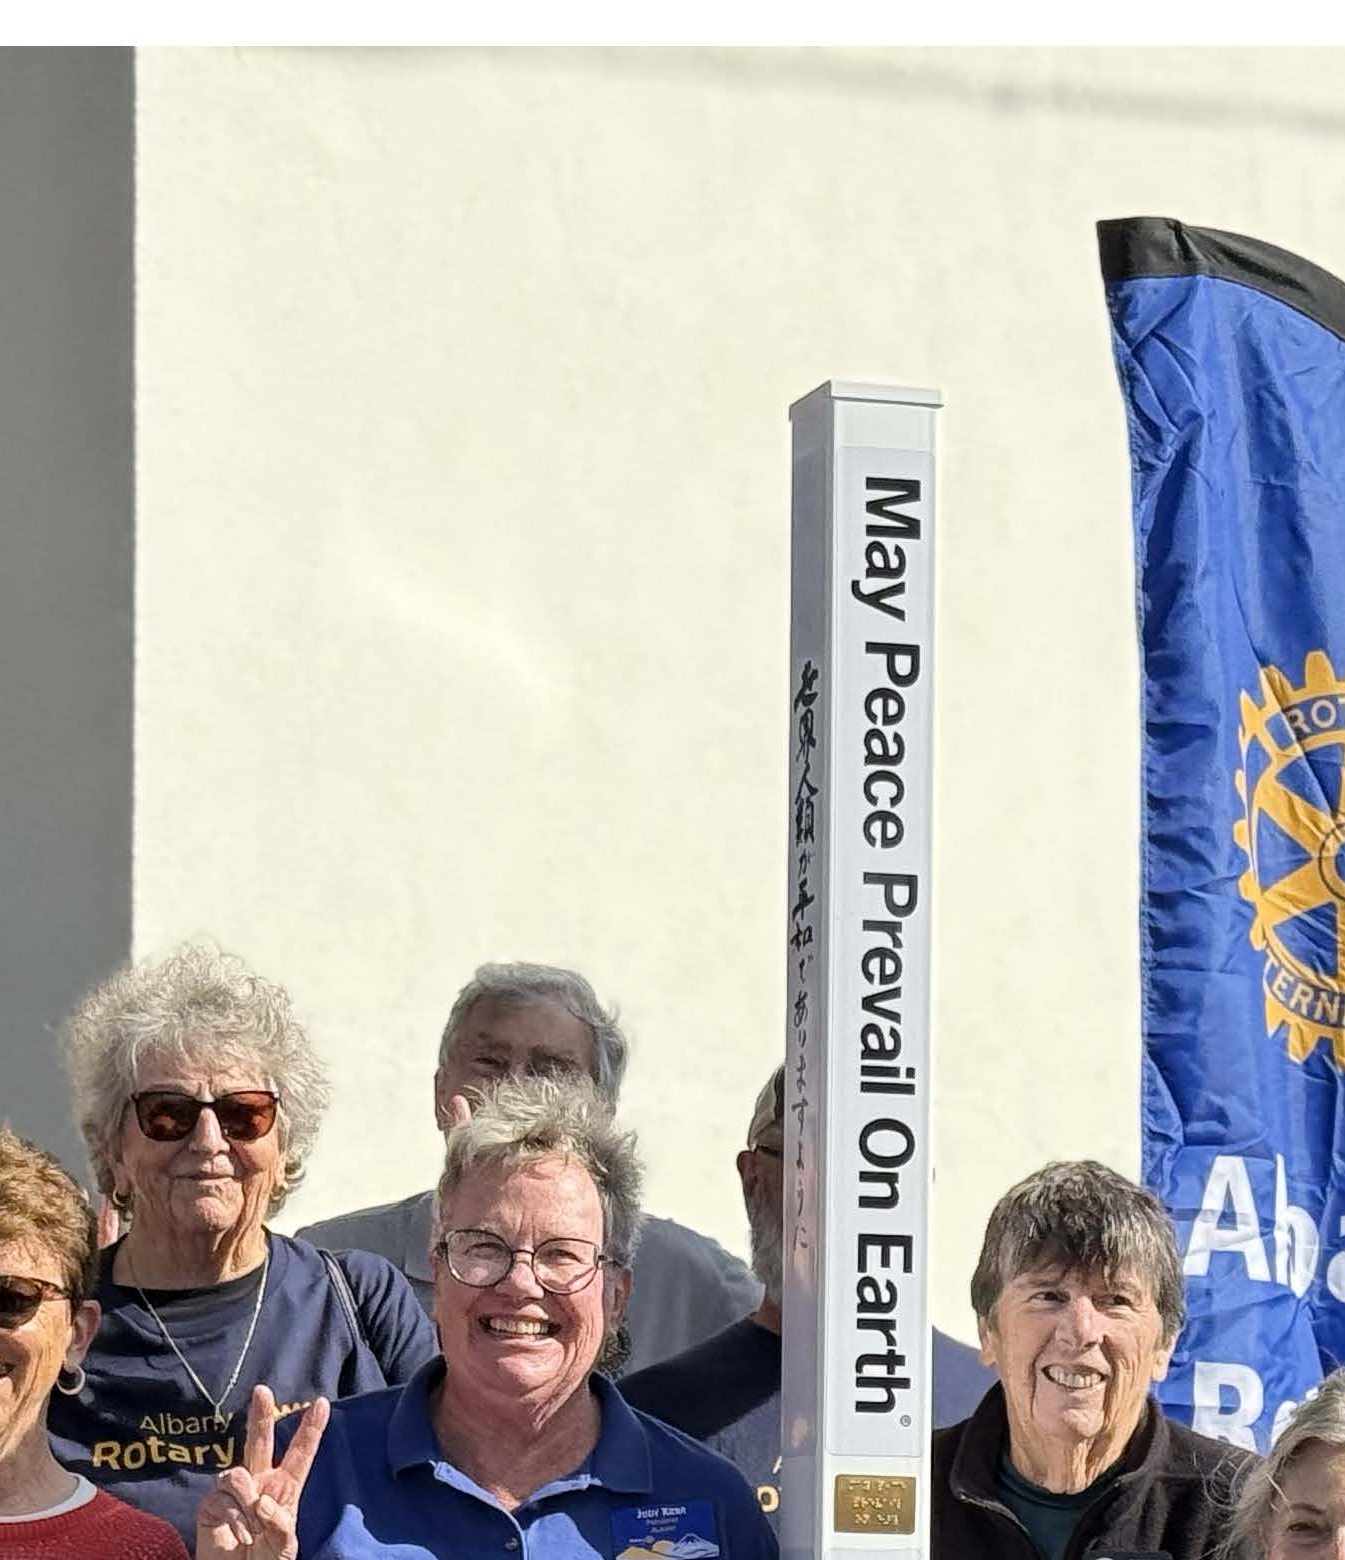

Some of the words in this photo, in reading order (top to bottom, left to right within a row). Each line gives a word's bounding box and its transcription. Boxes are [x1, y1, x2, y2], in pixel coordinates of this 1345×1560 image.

[851, 476, 921, 621] May
[862, 641, 920, 849] Peace
[857, 871, 919, 1095] Prevail
[858, 1117, 916, 1209] On
[92, 1436, 235, 1470] Rotary
[140, 1412, 234, 1436] Albany
